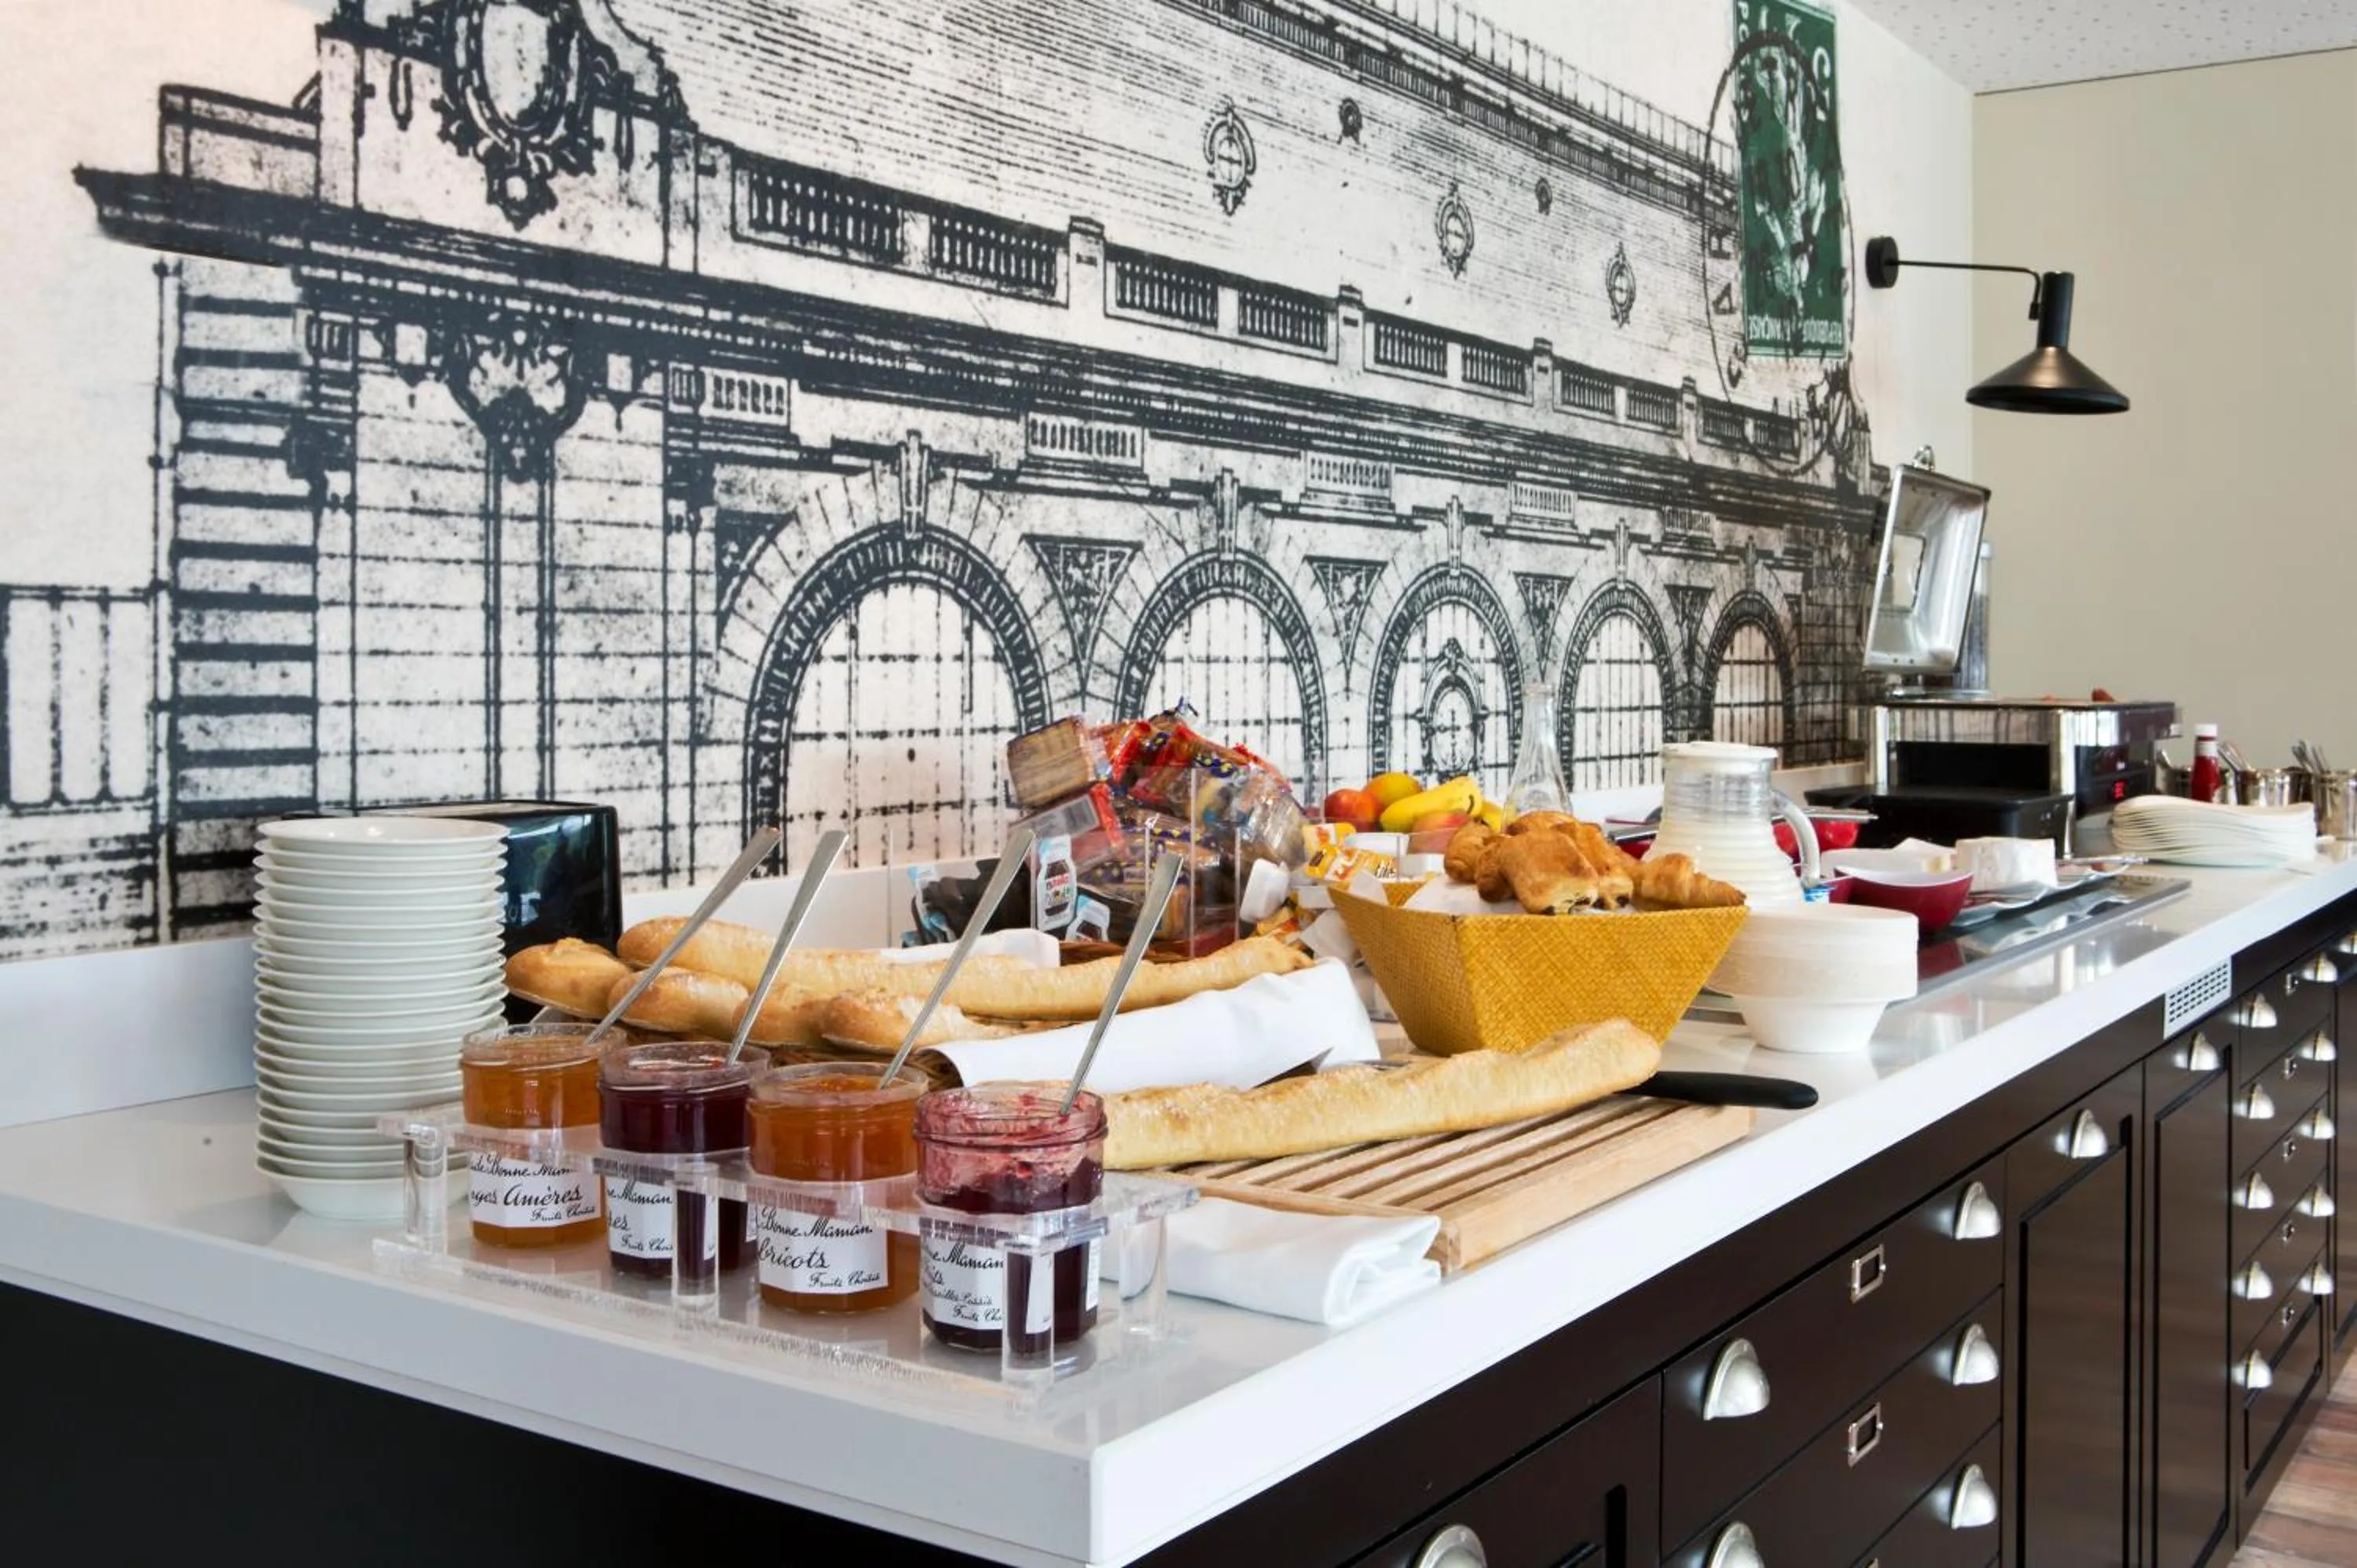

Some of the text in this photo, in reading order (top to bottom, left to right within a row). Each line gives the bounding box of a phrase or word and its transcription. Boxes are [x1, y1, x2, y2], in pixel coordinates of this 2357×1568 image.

[759, 1206, 873, 1238] Bonne Maman
[759, 1237, 830, 1269] bricots
